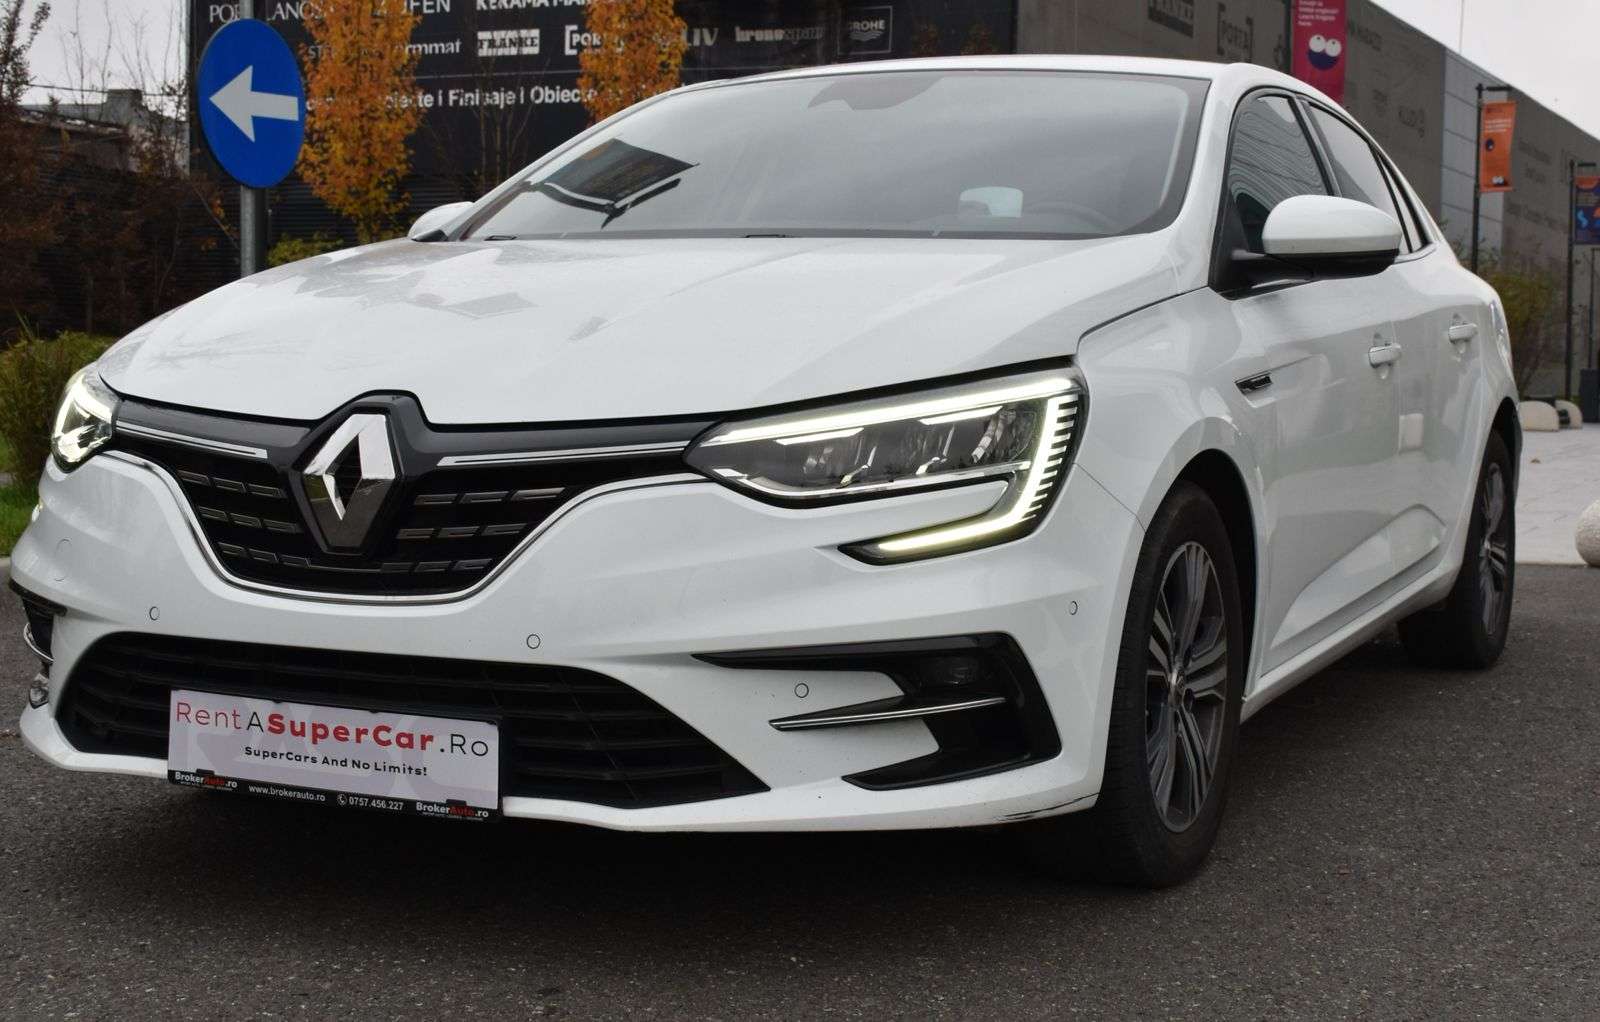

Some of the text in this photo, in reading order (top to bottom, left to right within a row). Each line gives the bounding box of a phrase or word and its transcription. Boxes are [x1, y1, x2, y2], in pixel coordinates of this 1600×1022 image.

[245, 747, 428, 776] SuperCars And No Limits!
[174, 771, 238, 788] BrokerAuto.ro
[248, 784, 326, 802] www.brokerauto.ro
[415, 801, 489, 818] BrokerAuto.ro
